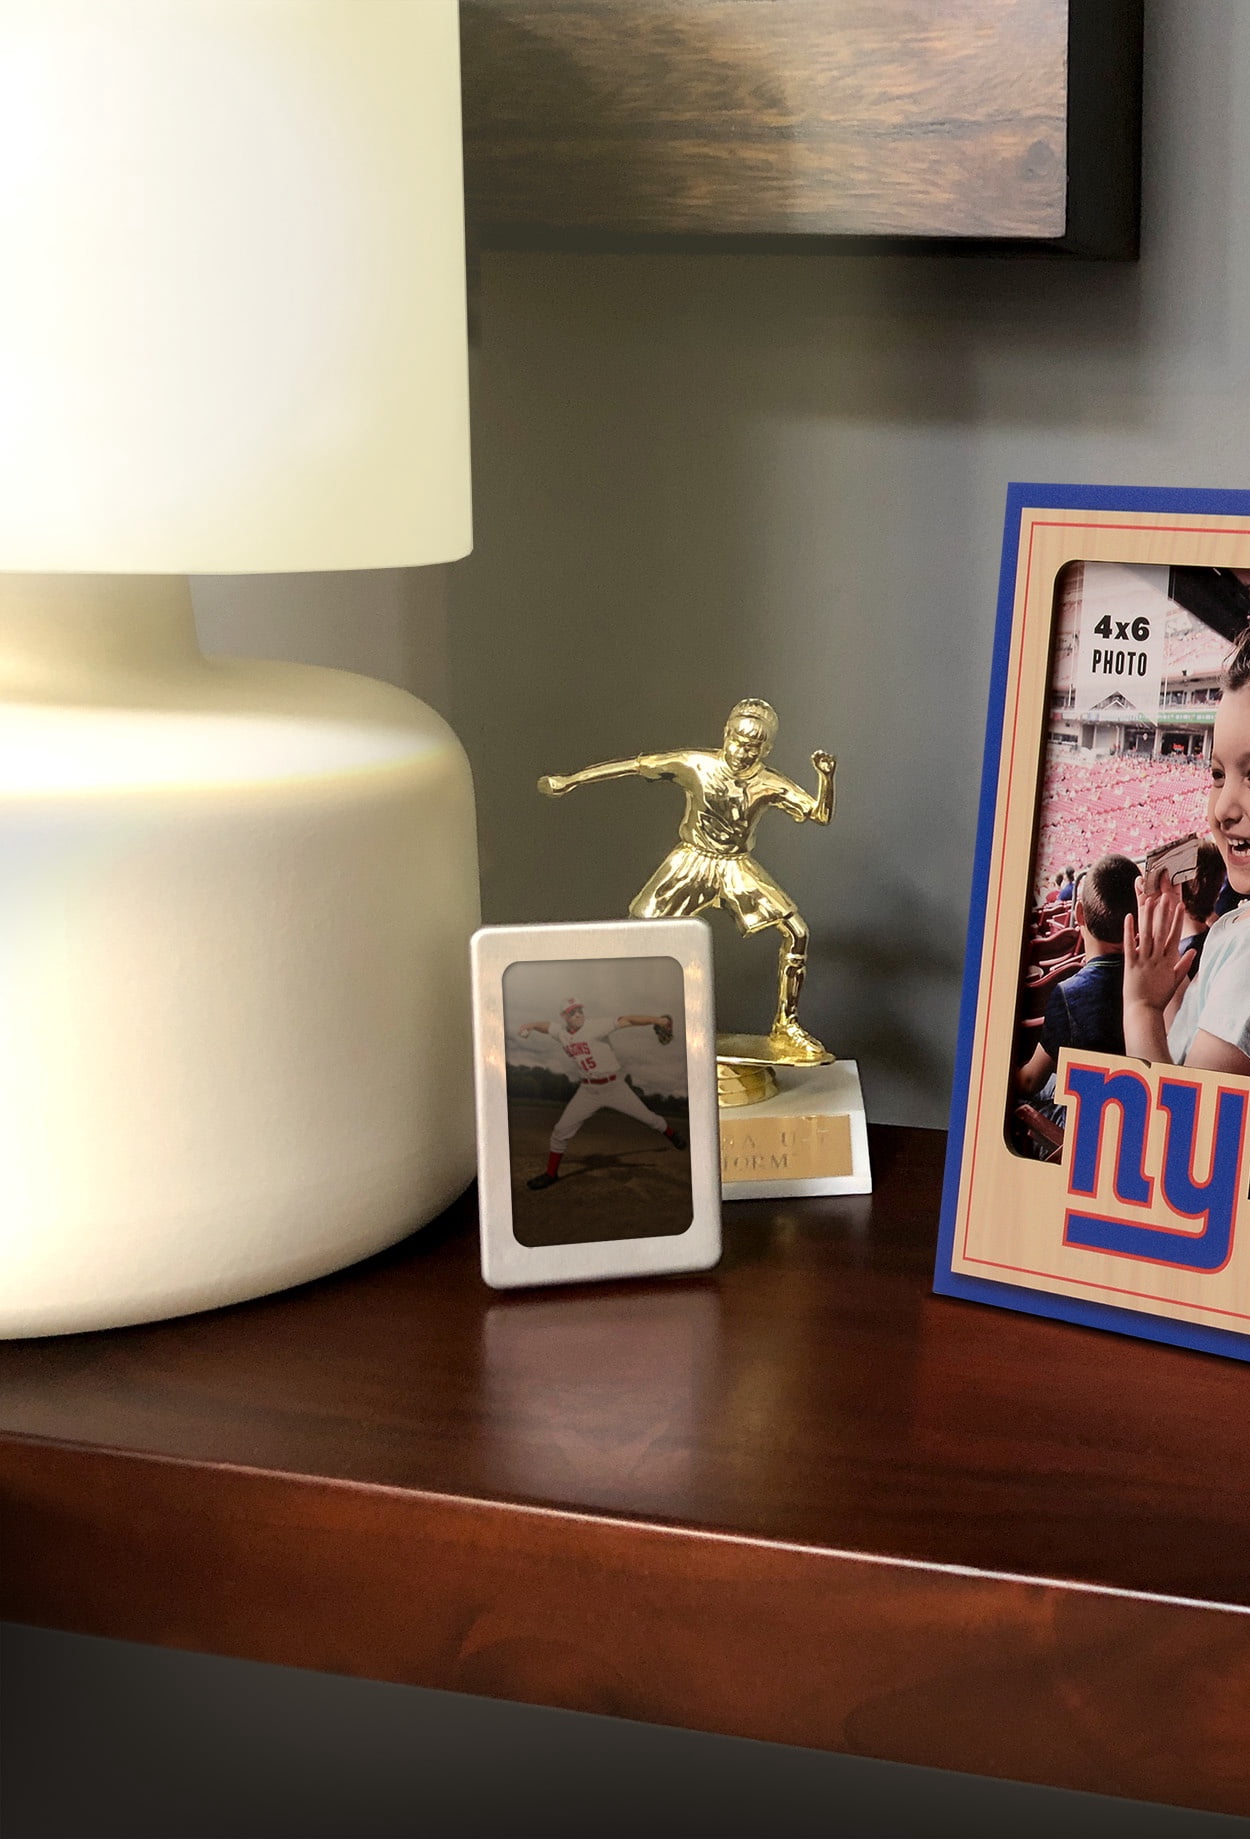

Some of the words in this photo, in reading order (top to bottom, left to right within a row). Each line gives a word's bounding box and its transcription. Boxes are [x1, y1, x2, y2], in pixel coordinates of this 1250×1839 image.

[1094, 614, 1150, 642] 4x6
[1092, 649, 1147, 677] PHOTO
[581, 1056, 597, 1072] 15
